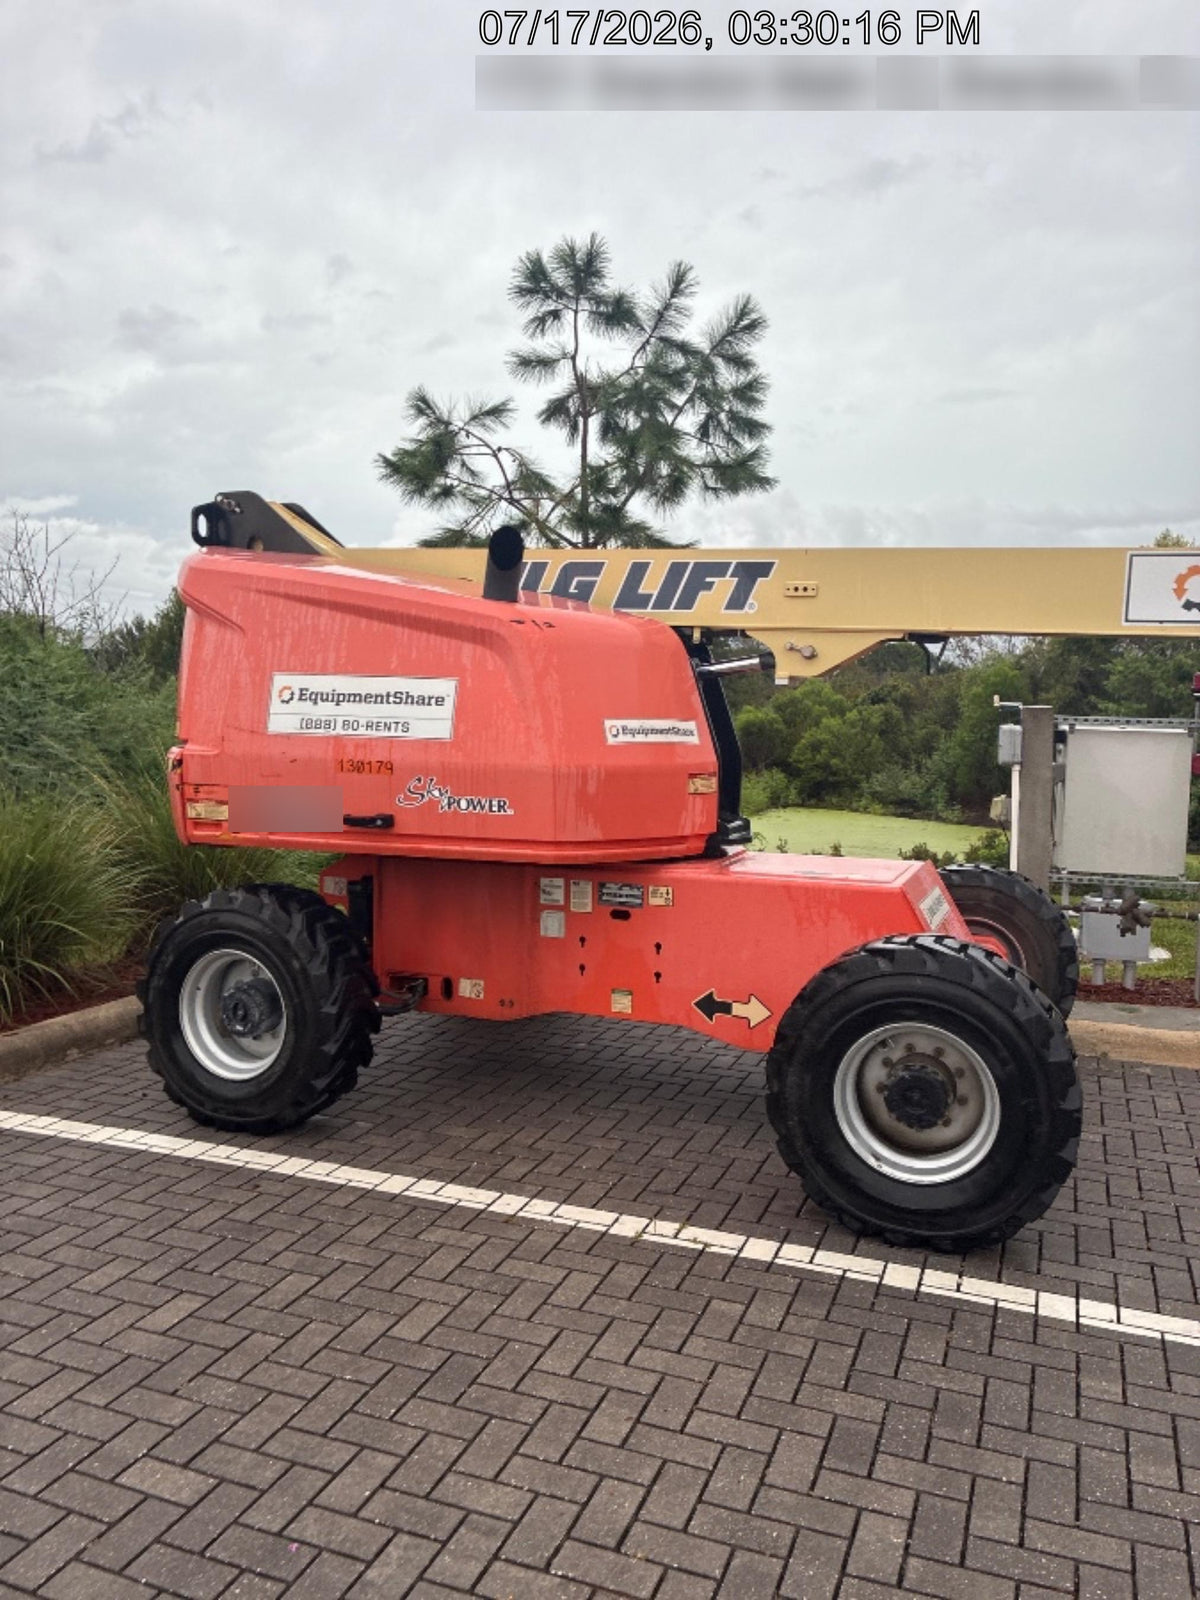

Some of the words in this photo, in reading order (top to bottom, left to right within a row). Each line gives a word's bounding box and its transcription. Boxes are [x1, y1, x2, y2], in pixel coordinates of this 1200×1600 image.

[519, 560, 608, 603] LG
[612, 560, 778, 613] LIFT
[297, 687, 446, 707] EquipmentShare
[341, 719, 411, 733] 80-RENTS
[446, 795, 509, 814] POWER
